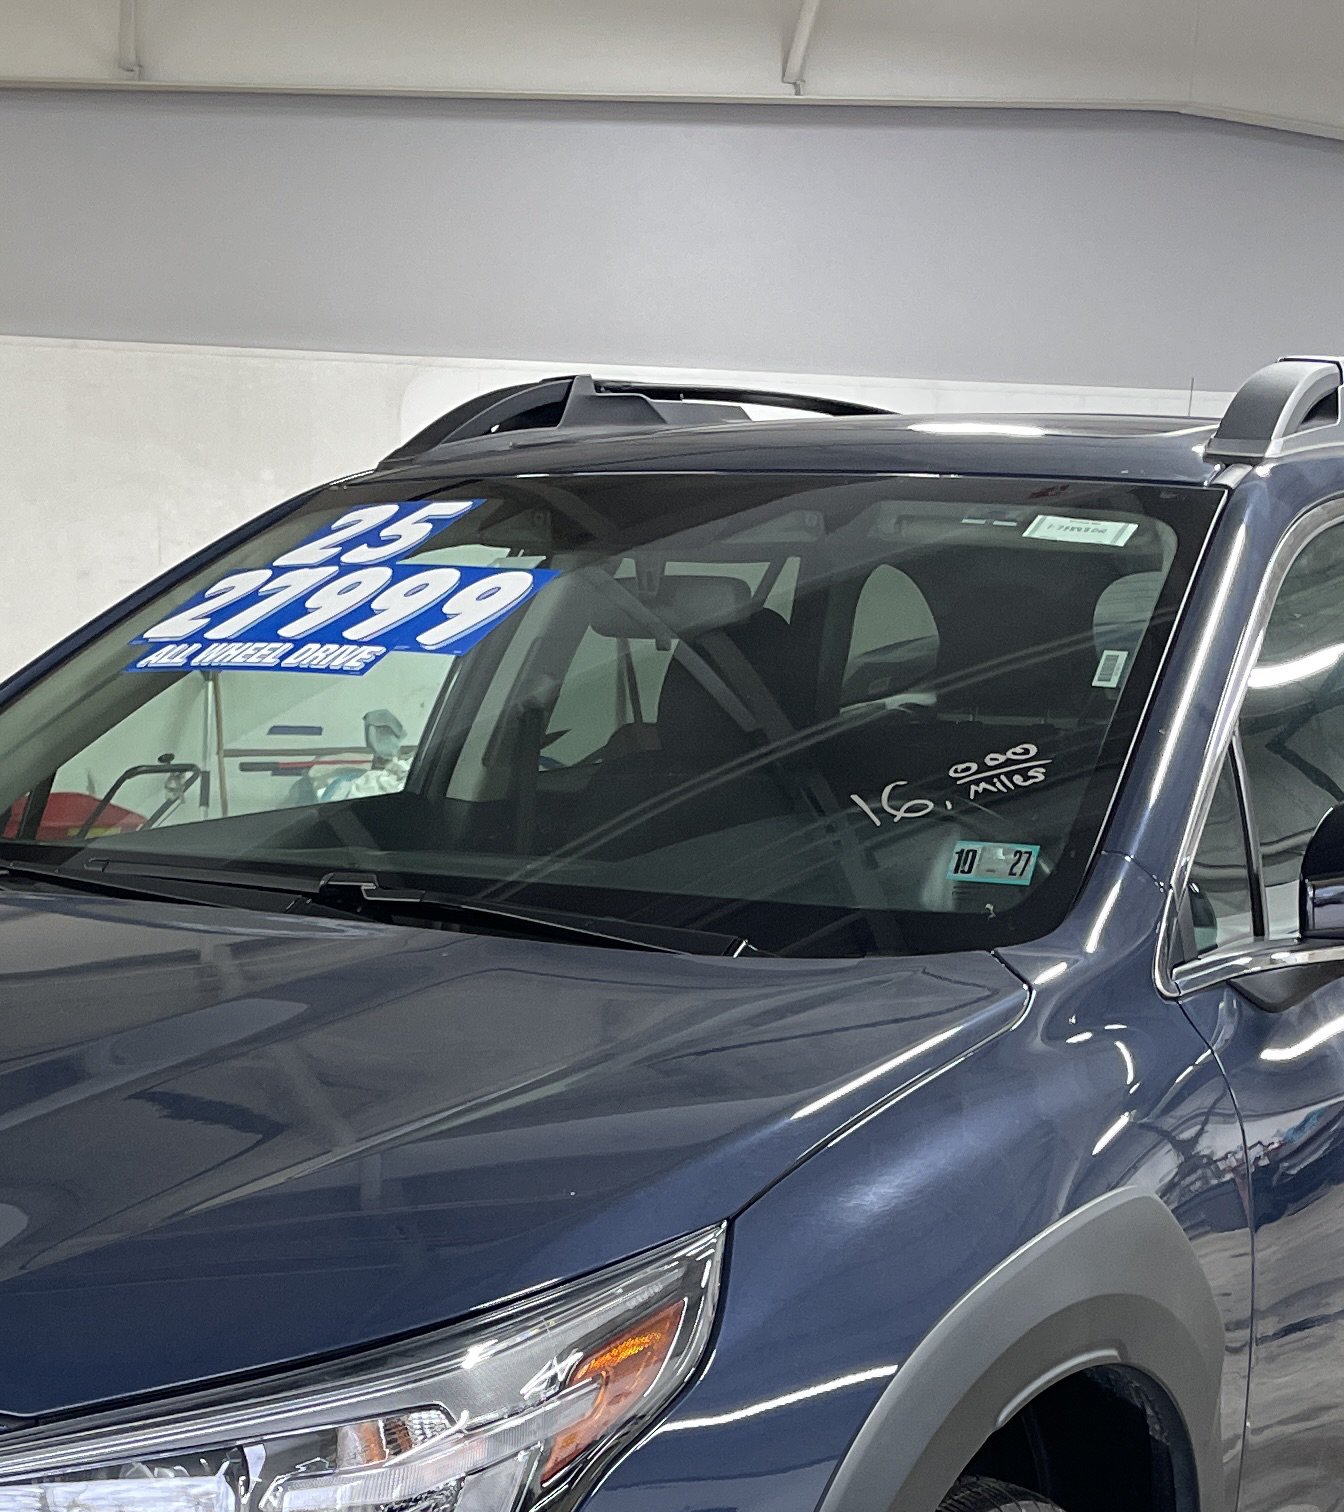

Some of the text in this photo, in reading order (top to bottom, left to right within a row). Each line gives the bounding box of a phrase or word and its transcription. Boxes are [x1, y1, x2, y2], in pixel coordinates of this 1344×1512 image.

[271, 501, 474, 567] 25
[142, 565, 534, 650] 27999
[136, 642, 387, 671] ALL WHEEL DRIVE
[953, 848, 978, 875] 10
[1008, 849, 1033, 877] 27
